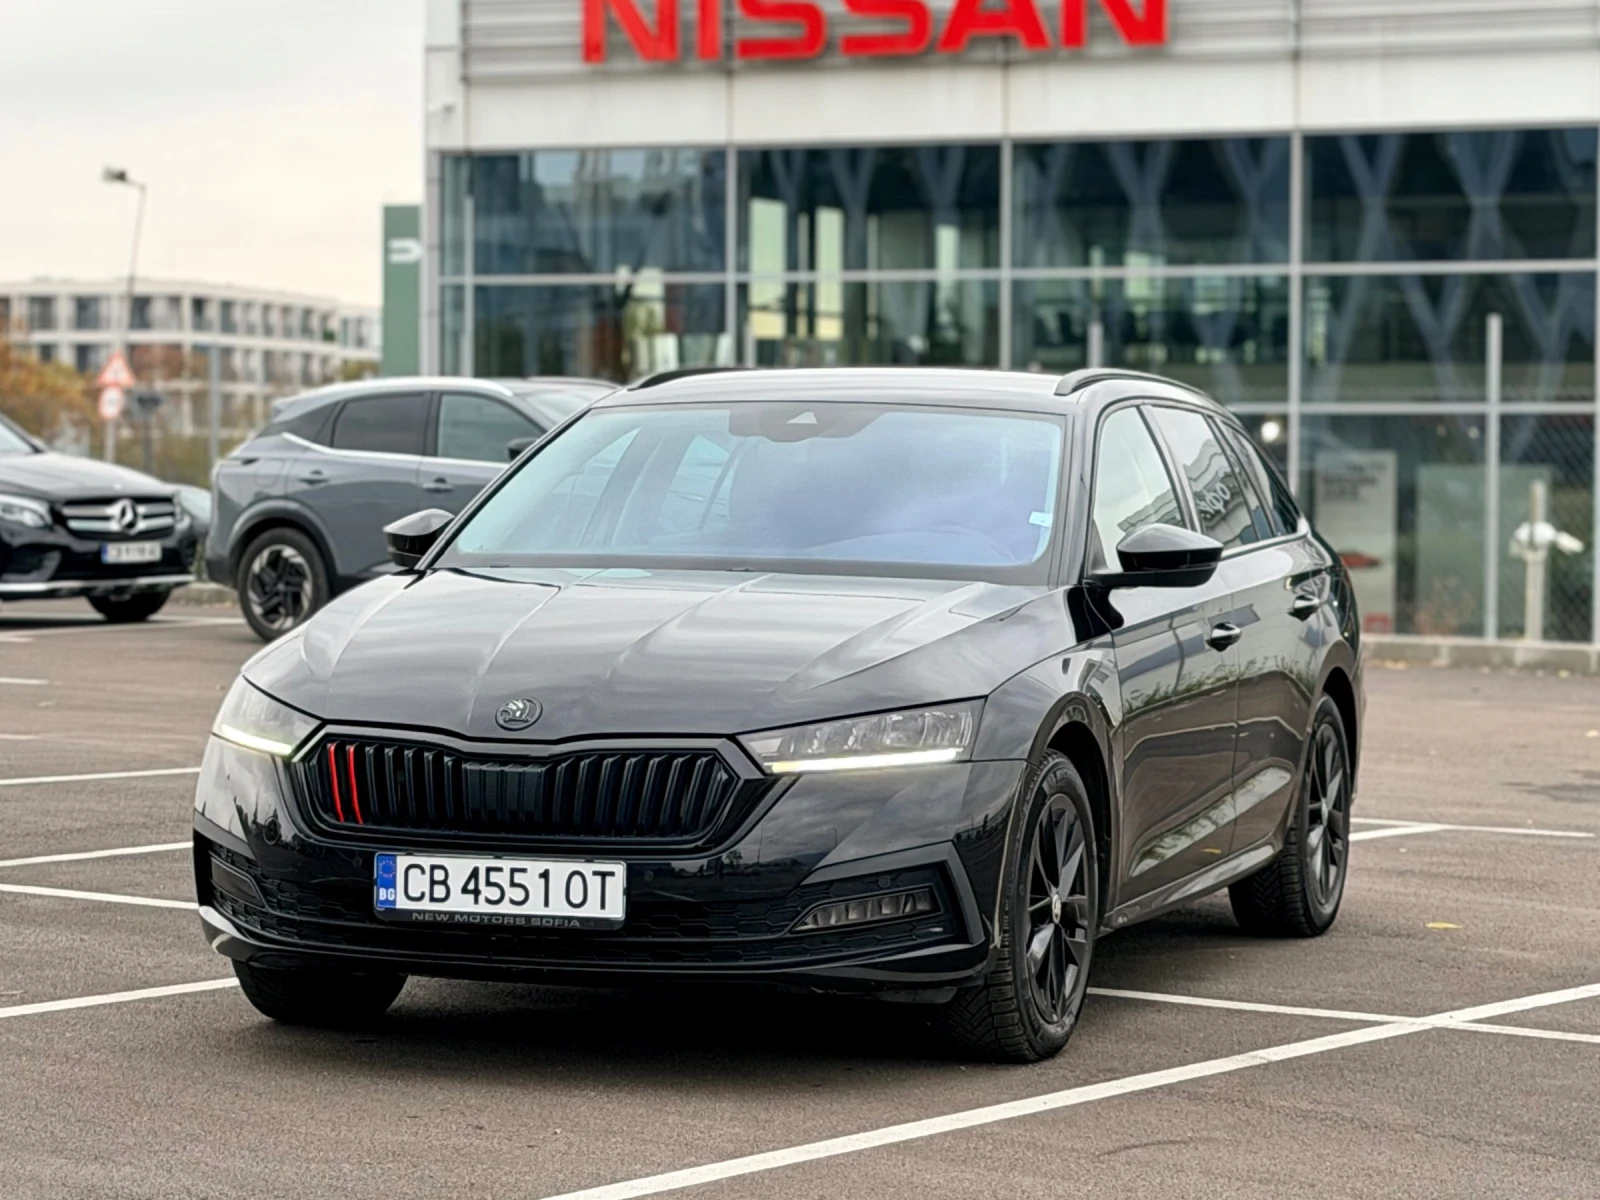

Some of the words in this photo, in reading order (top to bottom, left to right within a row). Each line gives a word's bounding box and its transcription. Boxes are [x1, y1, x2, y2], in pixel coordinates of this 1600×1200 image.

[582, 0, 1168, 63] NISSAN
[379, 888, 396, 900] BG
[403, 863, 451, 904] CB
[461, 866, 550, 908] 4551
[564, 870, 616, 911] OT
[412, 912, 449, 922] NEW
[454, 914, 525, 926] MOTORS
[530, 918, 581, 928] SOFIA
